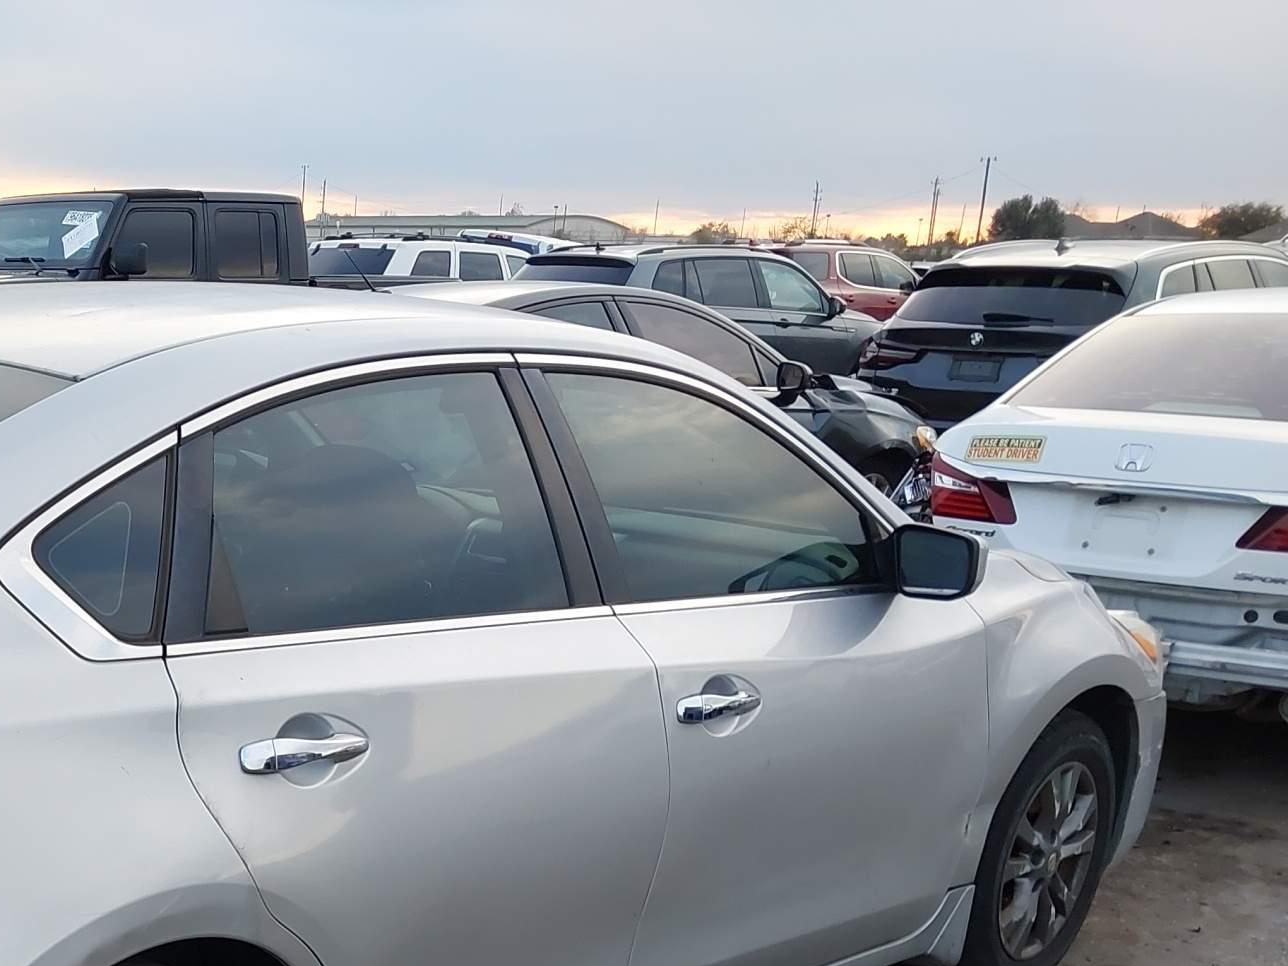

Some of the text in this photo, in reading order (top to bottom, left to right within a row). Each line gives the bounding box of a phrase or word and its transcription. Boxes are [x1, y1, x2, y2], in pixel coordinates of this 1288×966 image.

[972, 438, 1041, 449] PLEASE BE PATIENT
[968, 448, 1039, 459] STUDENT DRIVER
[1233, 572, 1288, 584] SPOR
